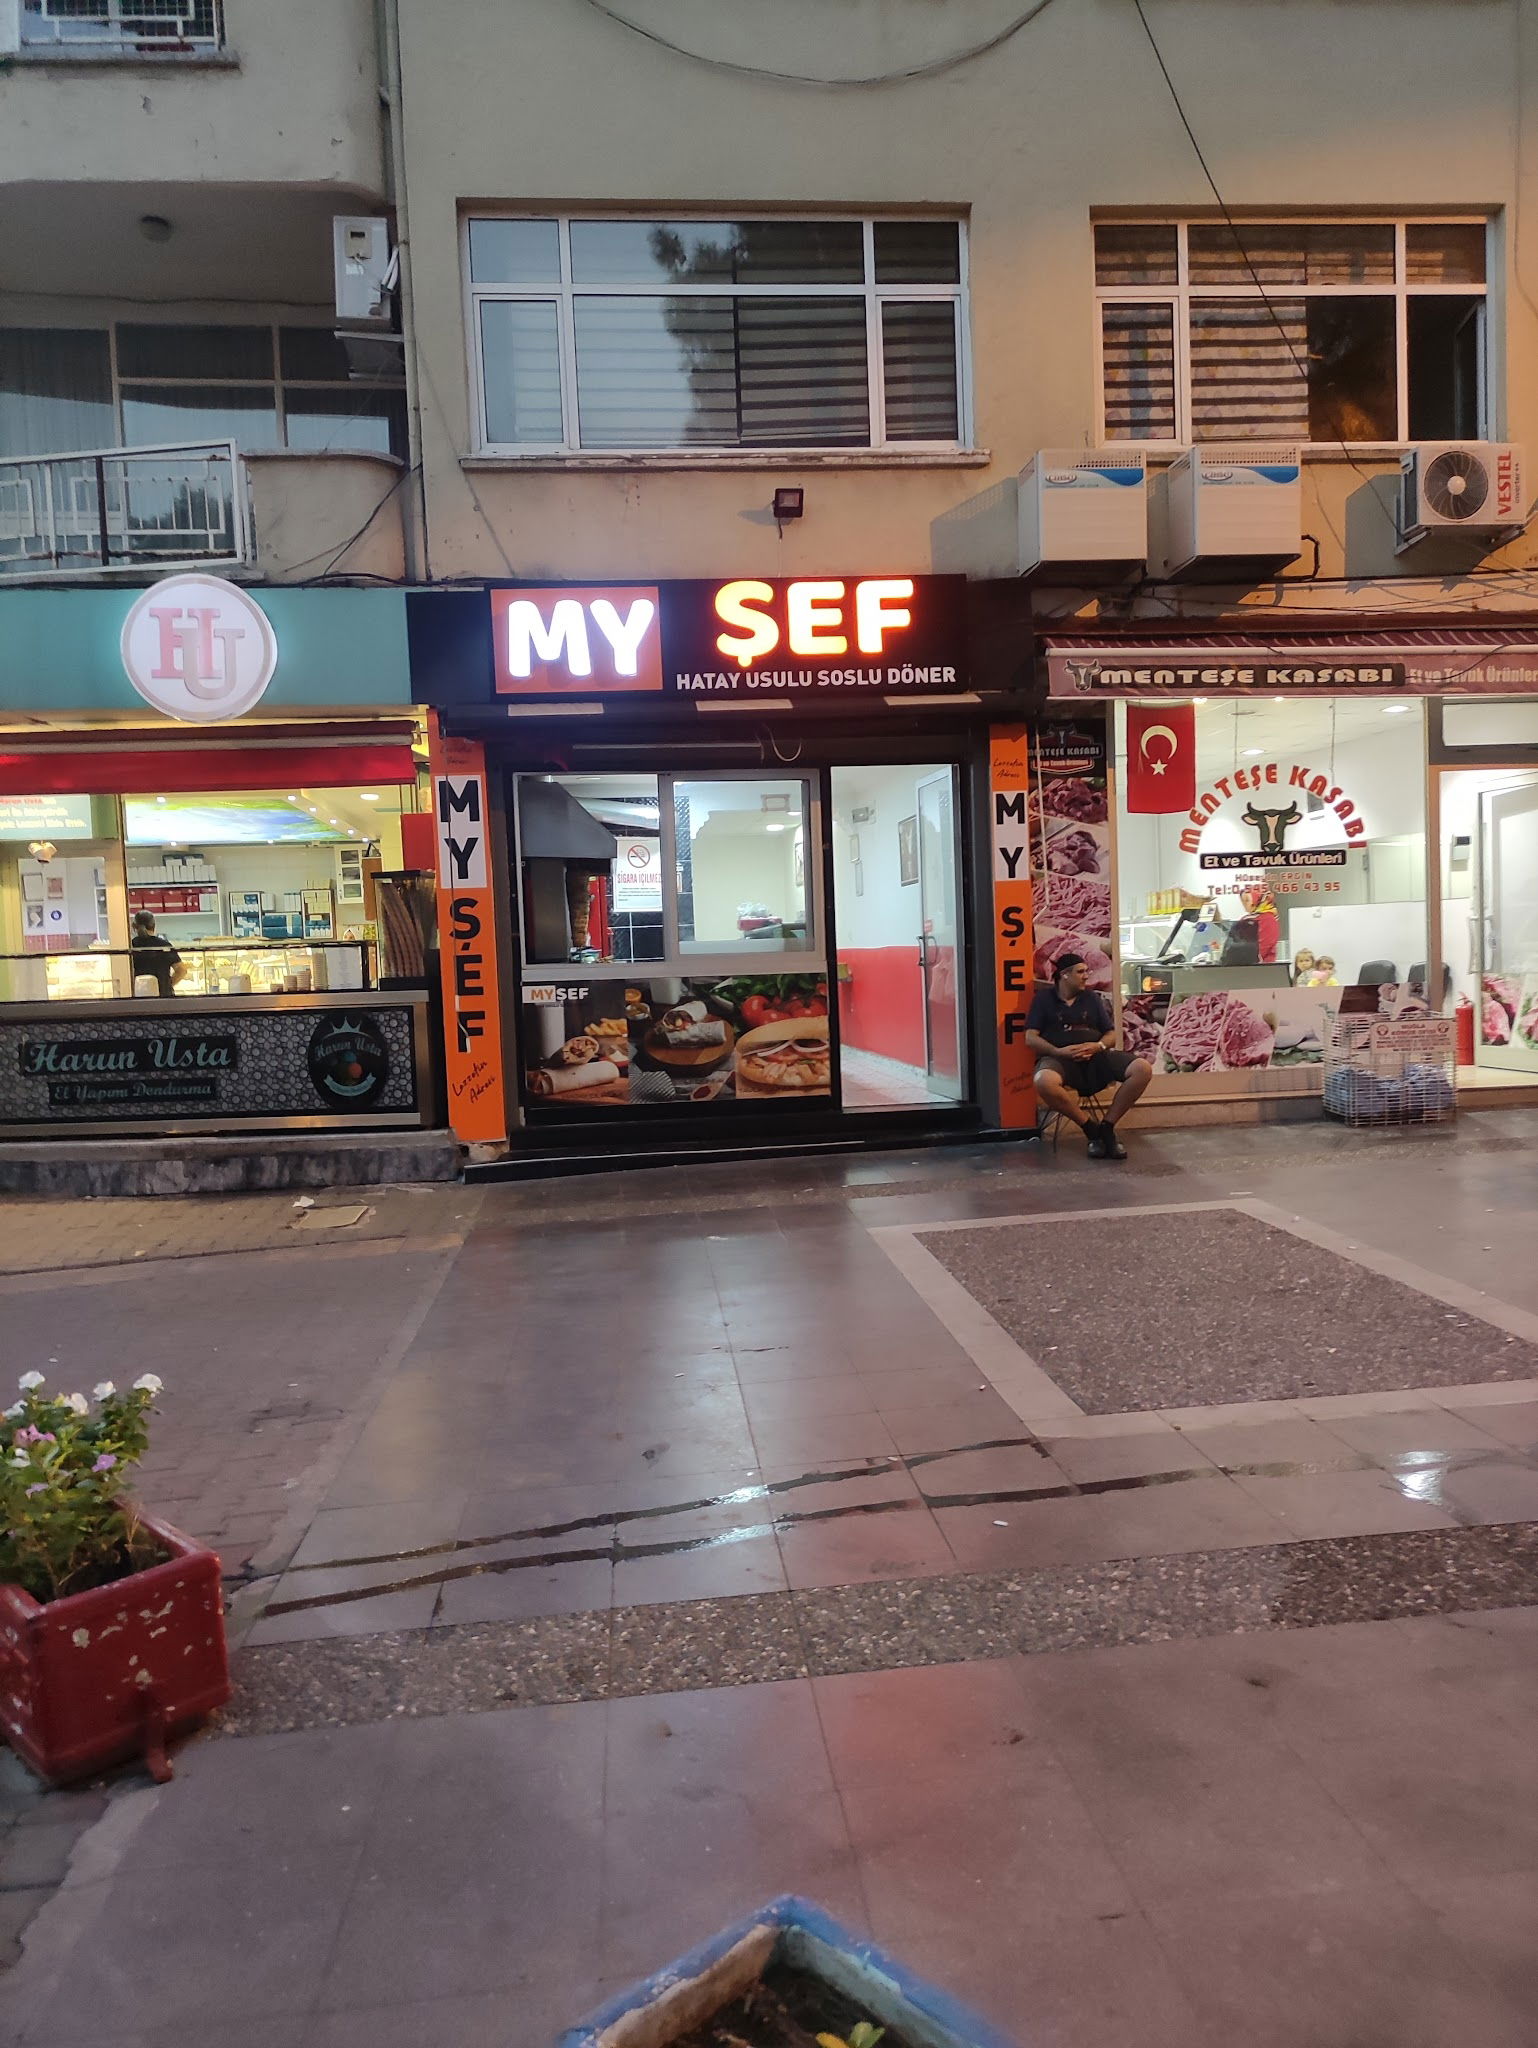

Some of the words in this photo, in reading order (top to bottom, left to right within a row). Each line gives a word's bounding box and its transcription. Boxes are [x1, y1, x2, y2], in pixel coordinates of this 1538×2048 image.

[1498, 450, 1511, 515] VESTEL
[507, 598, 655, 677] MY
[715, 579, 915, 668] ŞEF
[677, 673, 740, 691] HATAY
[745, 670, 813, 688] USULU
[817, 668, 882, 686] SOSLU
[888, 664, 956, 684] DÖNER
[1100, 669, 1255, 686] MENTEŞE
[1266, 669, 1393, 684] KASABI
[438, 780, 480, 879] MY
[1179, 763, 1278, 854] MENTEŞE
[1289, 765, 1368, 849] KASABI
[995, 792, 1026, 879] MY
[1204, 855, 1219, 868] Et
[1222, 856, 1241, 867] ve
[1243, 854, 1287, 866] Tavuk
[1289, 851, 1343, 865] Ürünleri
[1274, 883, 1298, 893] 466
[1304, 882, 1320, 892] 43
[1324, 882, 1341, 892] 95
[449, 897, 486, 1053] ŞEF
[531, 988, 554, 1000] MY
[1001, 906, 1026, 1045] ŞEF
[25, 1043, 139, 1073] Harun
[147, 1038, 232, 1068] Usta
[54, 1086, 70, 1100] El
